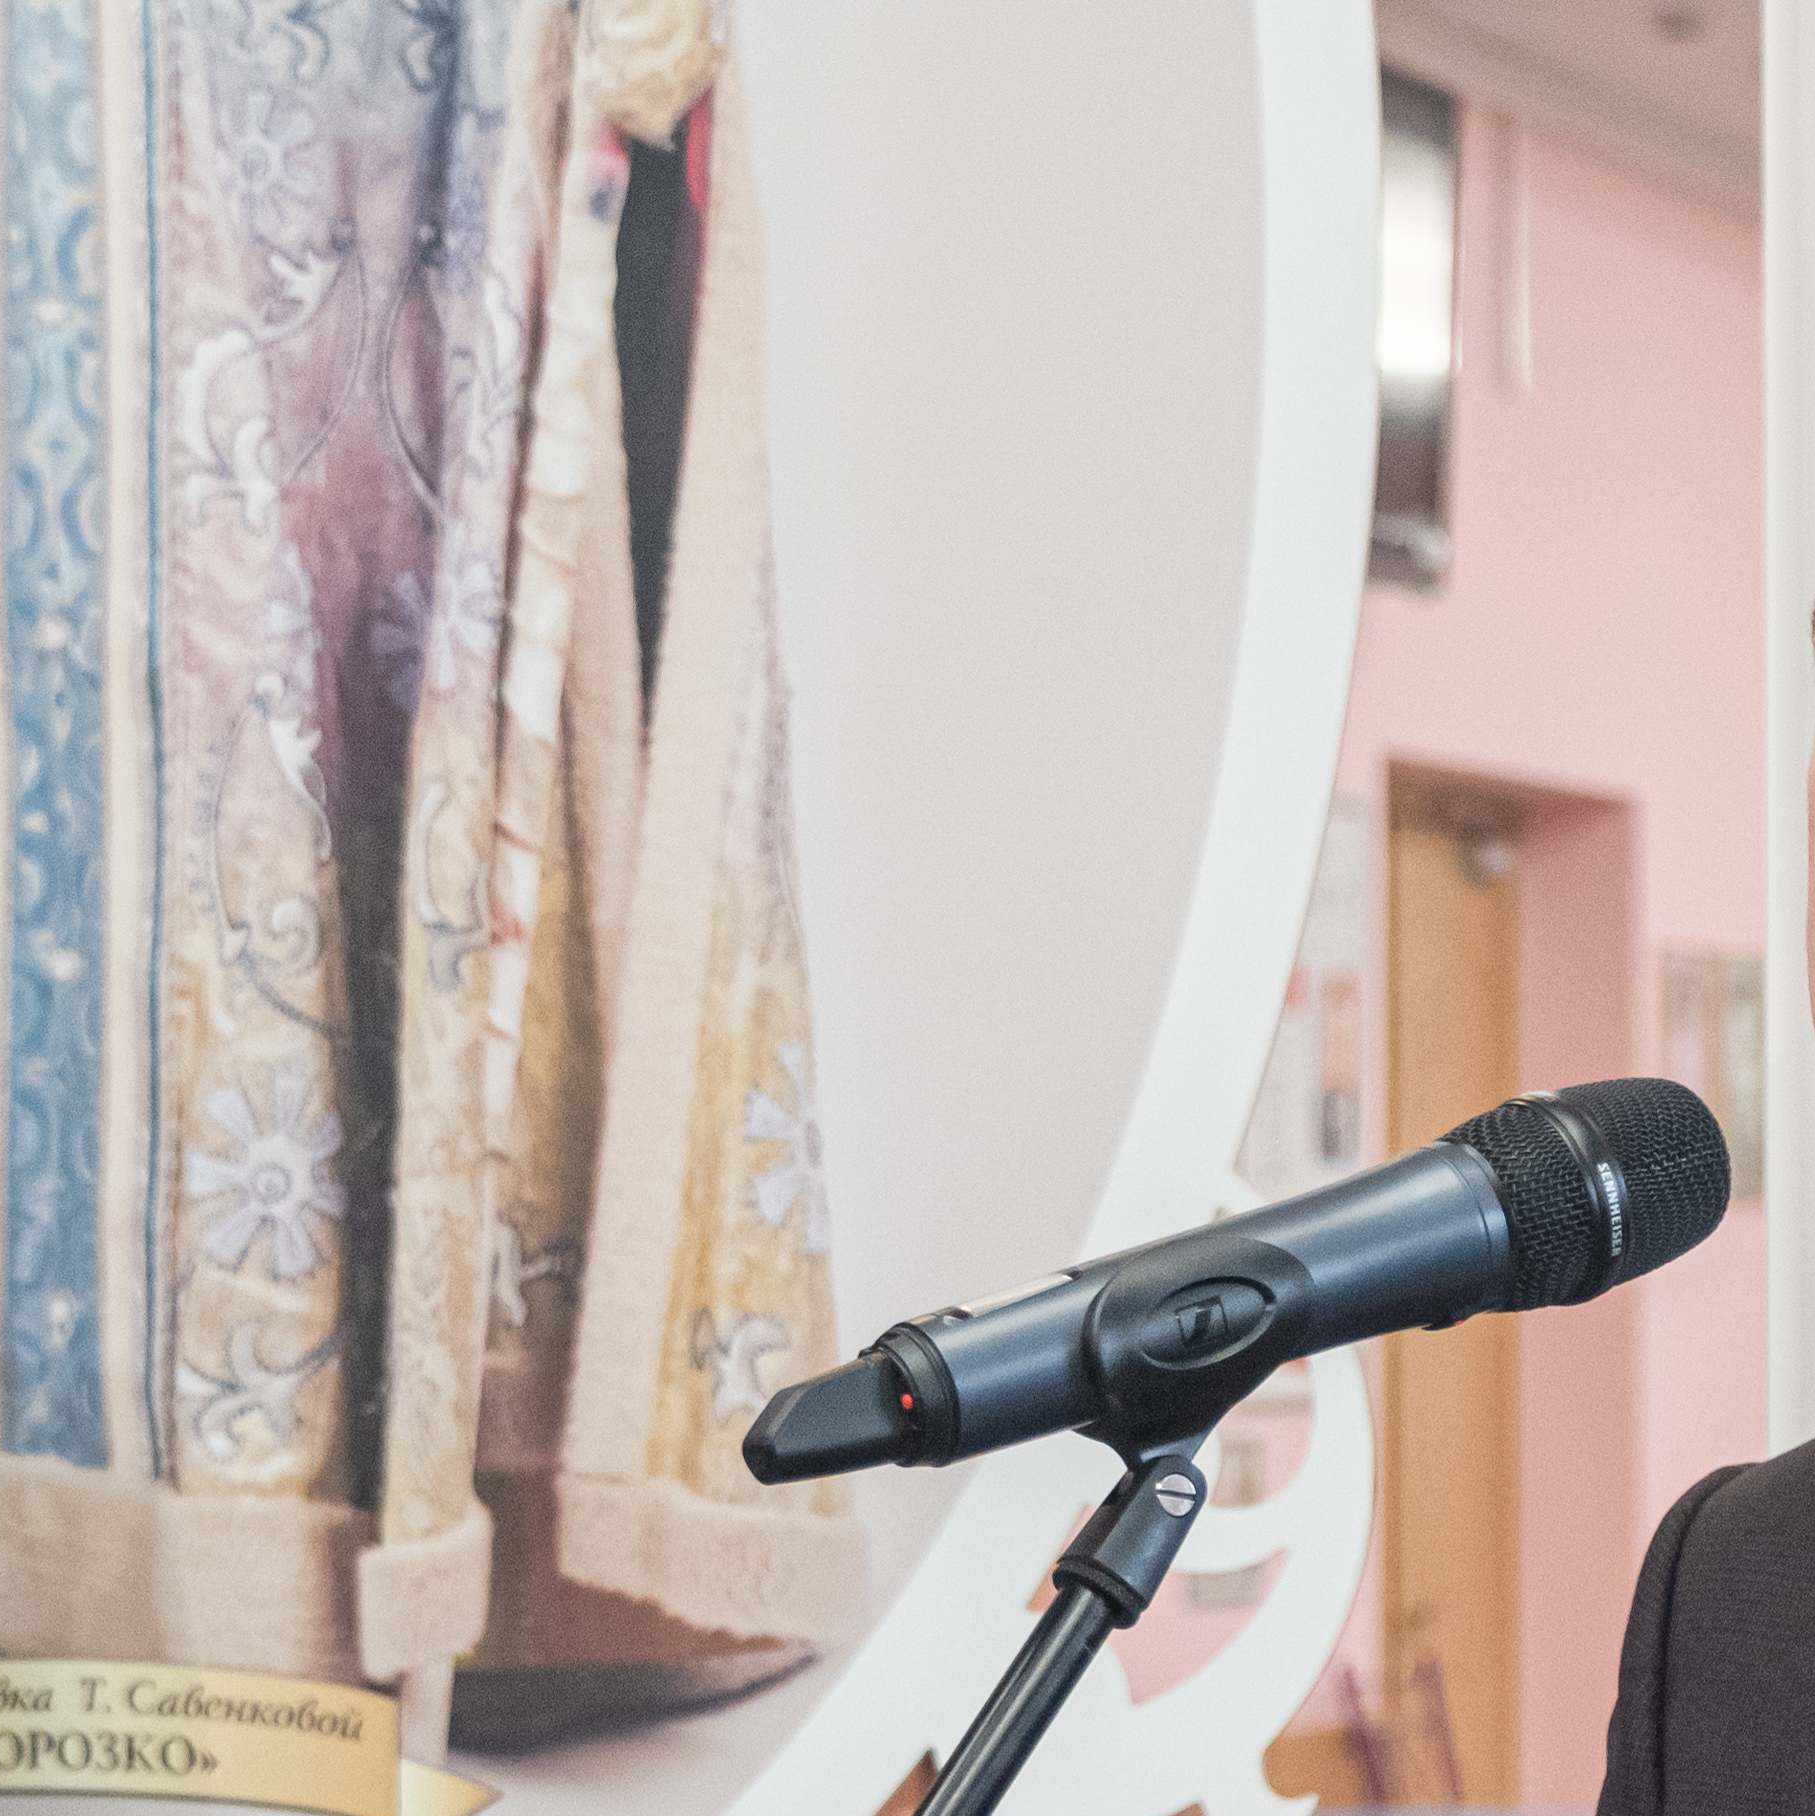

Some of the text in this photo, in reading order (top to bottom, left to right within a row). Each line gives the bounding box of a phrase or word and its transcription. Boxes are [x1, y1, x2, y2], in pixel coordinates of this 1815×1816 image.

[1596, 1162, 1623, 1257] SENNHEISER
[80, 1676, 112, 1714] Т.
[126, 1678, 364, 1742] Савенковой
